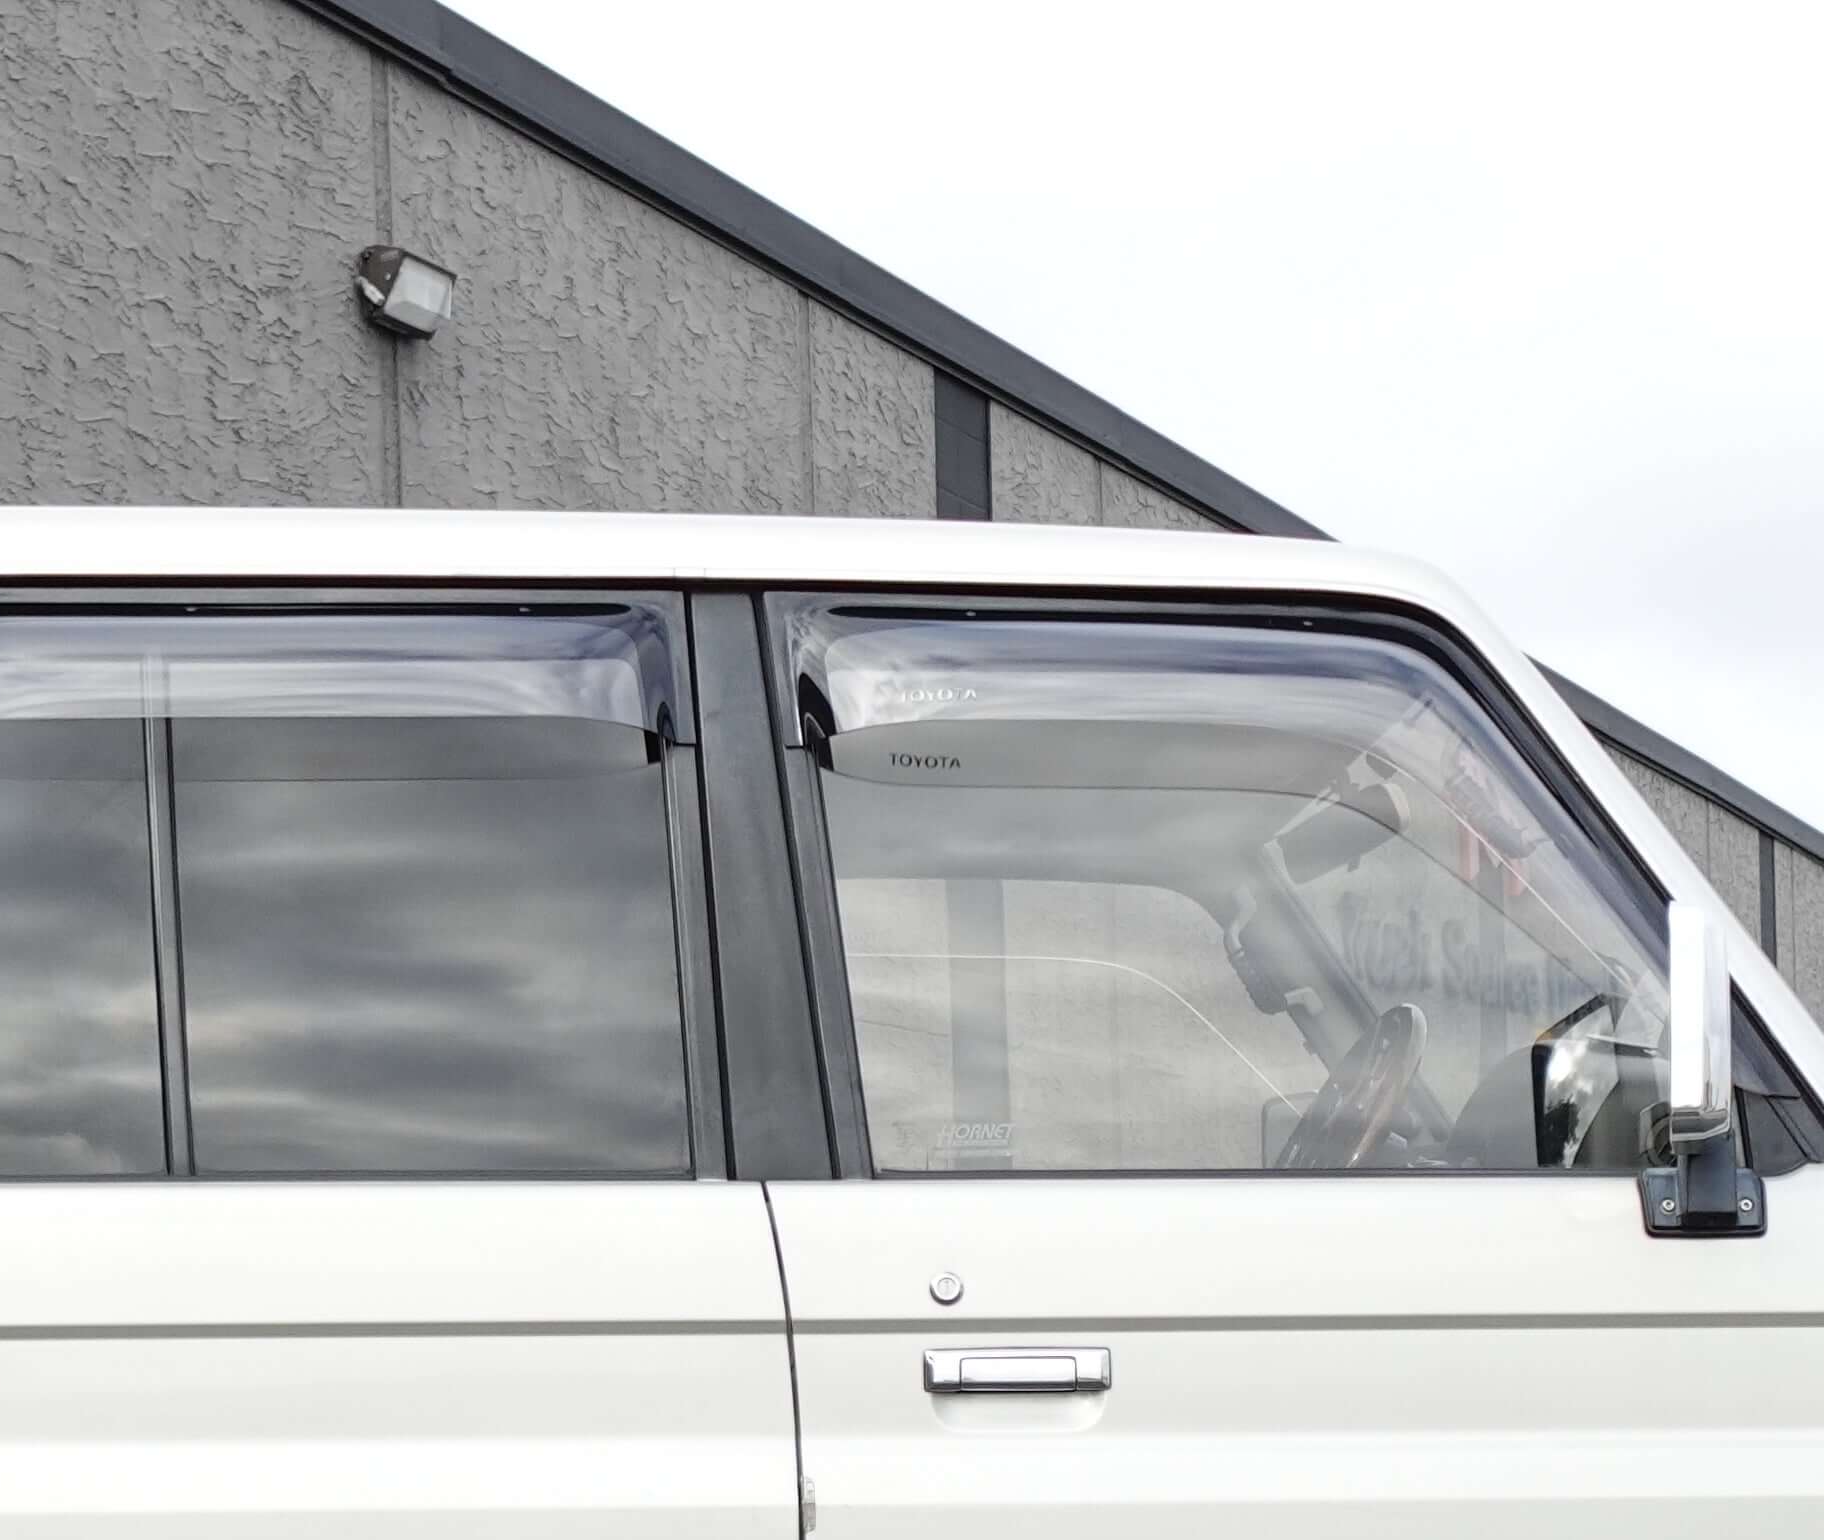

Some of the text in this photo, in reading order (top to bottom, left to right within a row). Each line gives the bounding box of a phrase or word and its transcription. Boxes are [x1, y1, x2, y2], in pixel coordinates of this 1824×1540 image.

[901, 688, 976, 702] TOYOTA
[888, 752, 961, 769] TOYOTA
[936, 1122, 1016, 1148] HORNET
